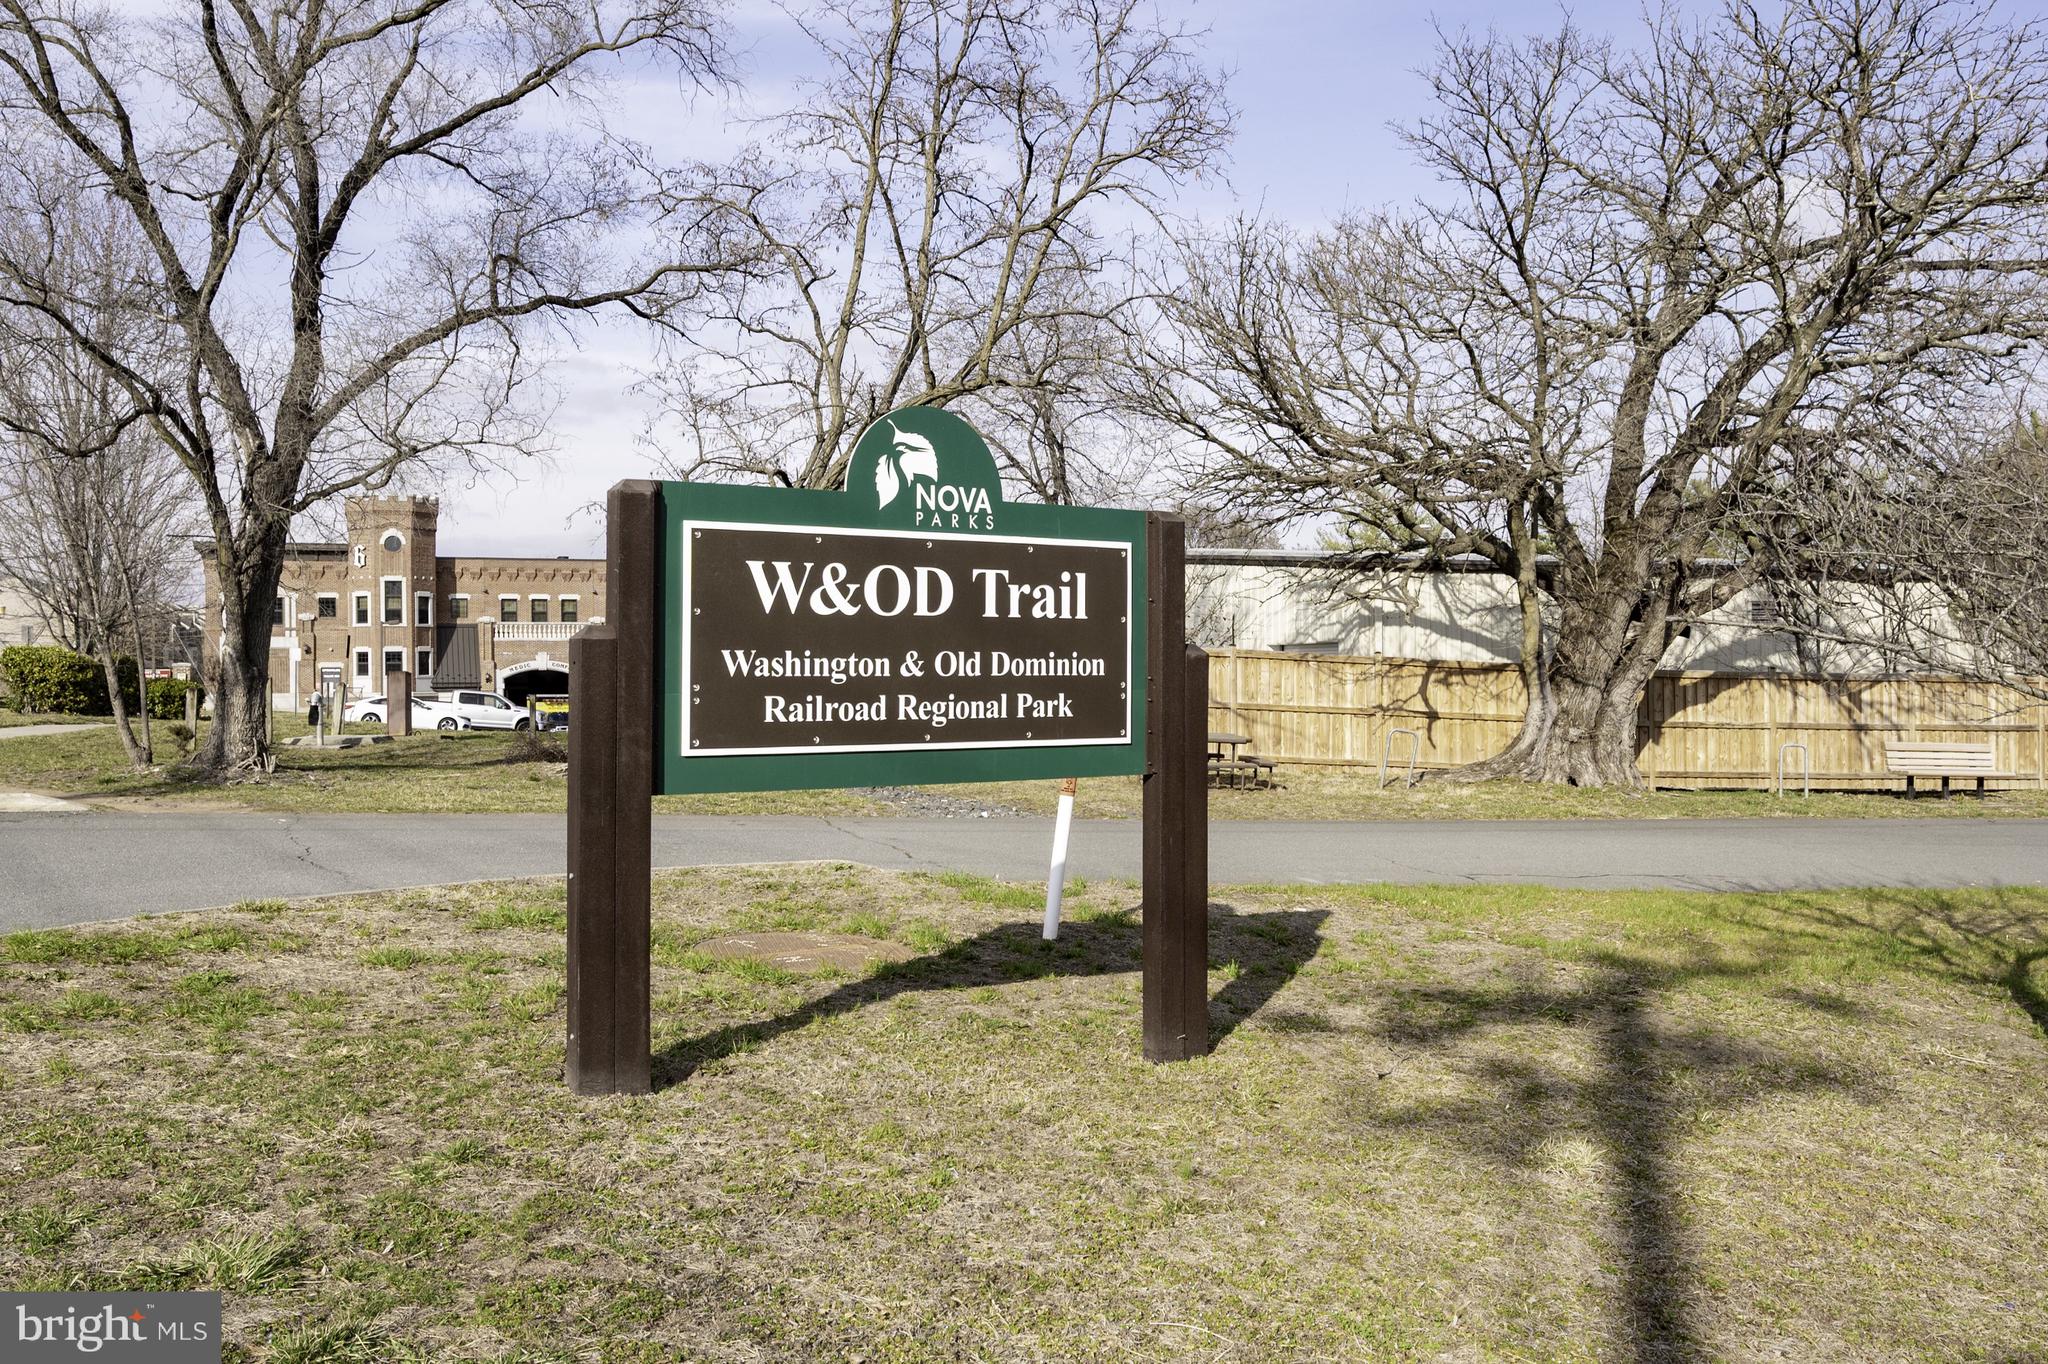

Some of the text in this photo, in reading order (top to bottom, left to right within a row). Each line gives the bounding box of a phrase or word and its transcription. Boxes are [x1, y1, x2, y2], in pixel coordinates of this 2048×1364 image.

[916, 483, 992, 514] NOVA
[916, 511, 994, 530] PARKS
[746, 560, 1089, 619] W&OD Trail
[508, 662, 531, 672] MEDIC
[721, 649, 1105, 684] Washington & Old Dominion
[763, 692, 1074, 727] Railroad Regional Park
